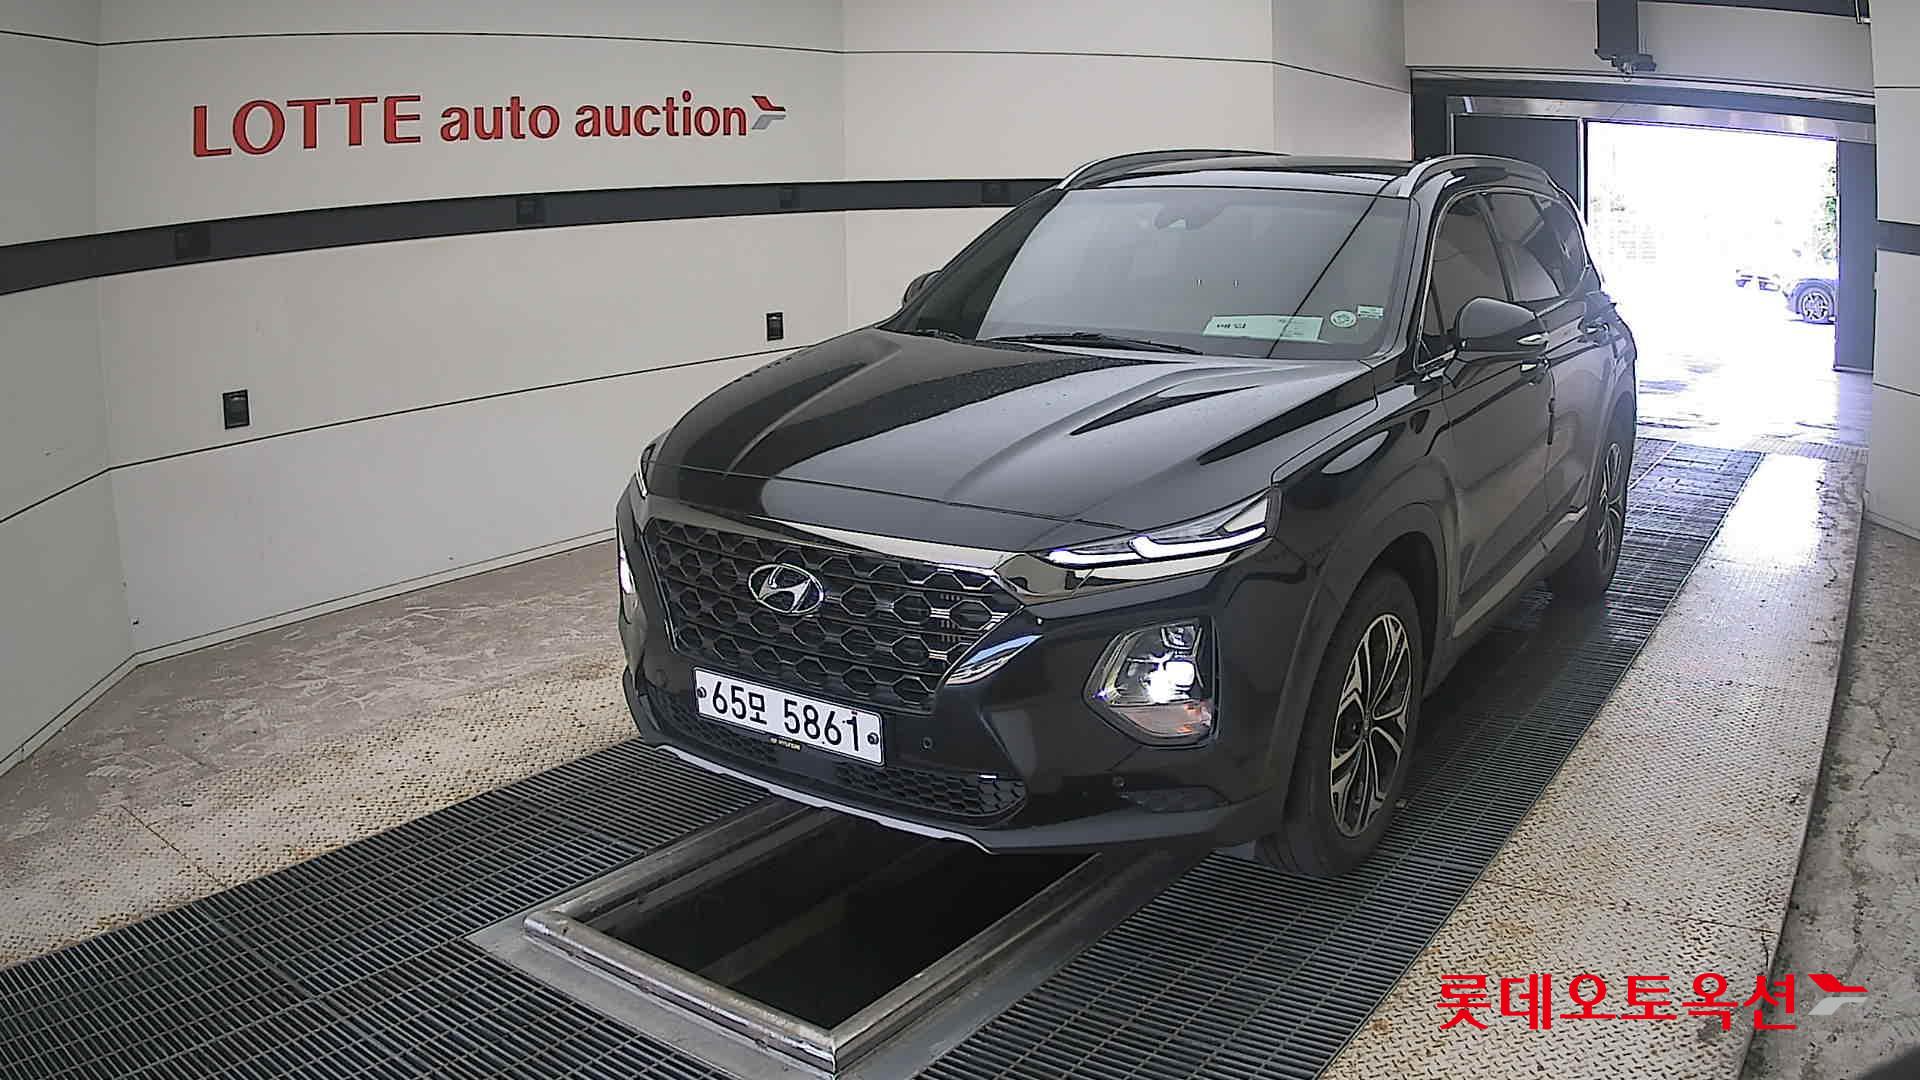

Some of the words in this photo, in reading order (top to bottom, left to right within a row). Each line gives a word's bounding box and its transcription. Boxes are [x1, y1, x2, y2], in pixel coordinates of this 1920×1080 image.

[193, 95, 422, 158] LOTTE
[440, 96, 559, 142] auto
[575, 90, 749, 137] auction
[712, 681, 768, 725] 65모
[783, 699, 860, 751] 5861
